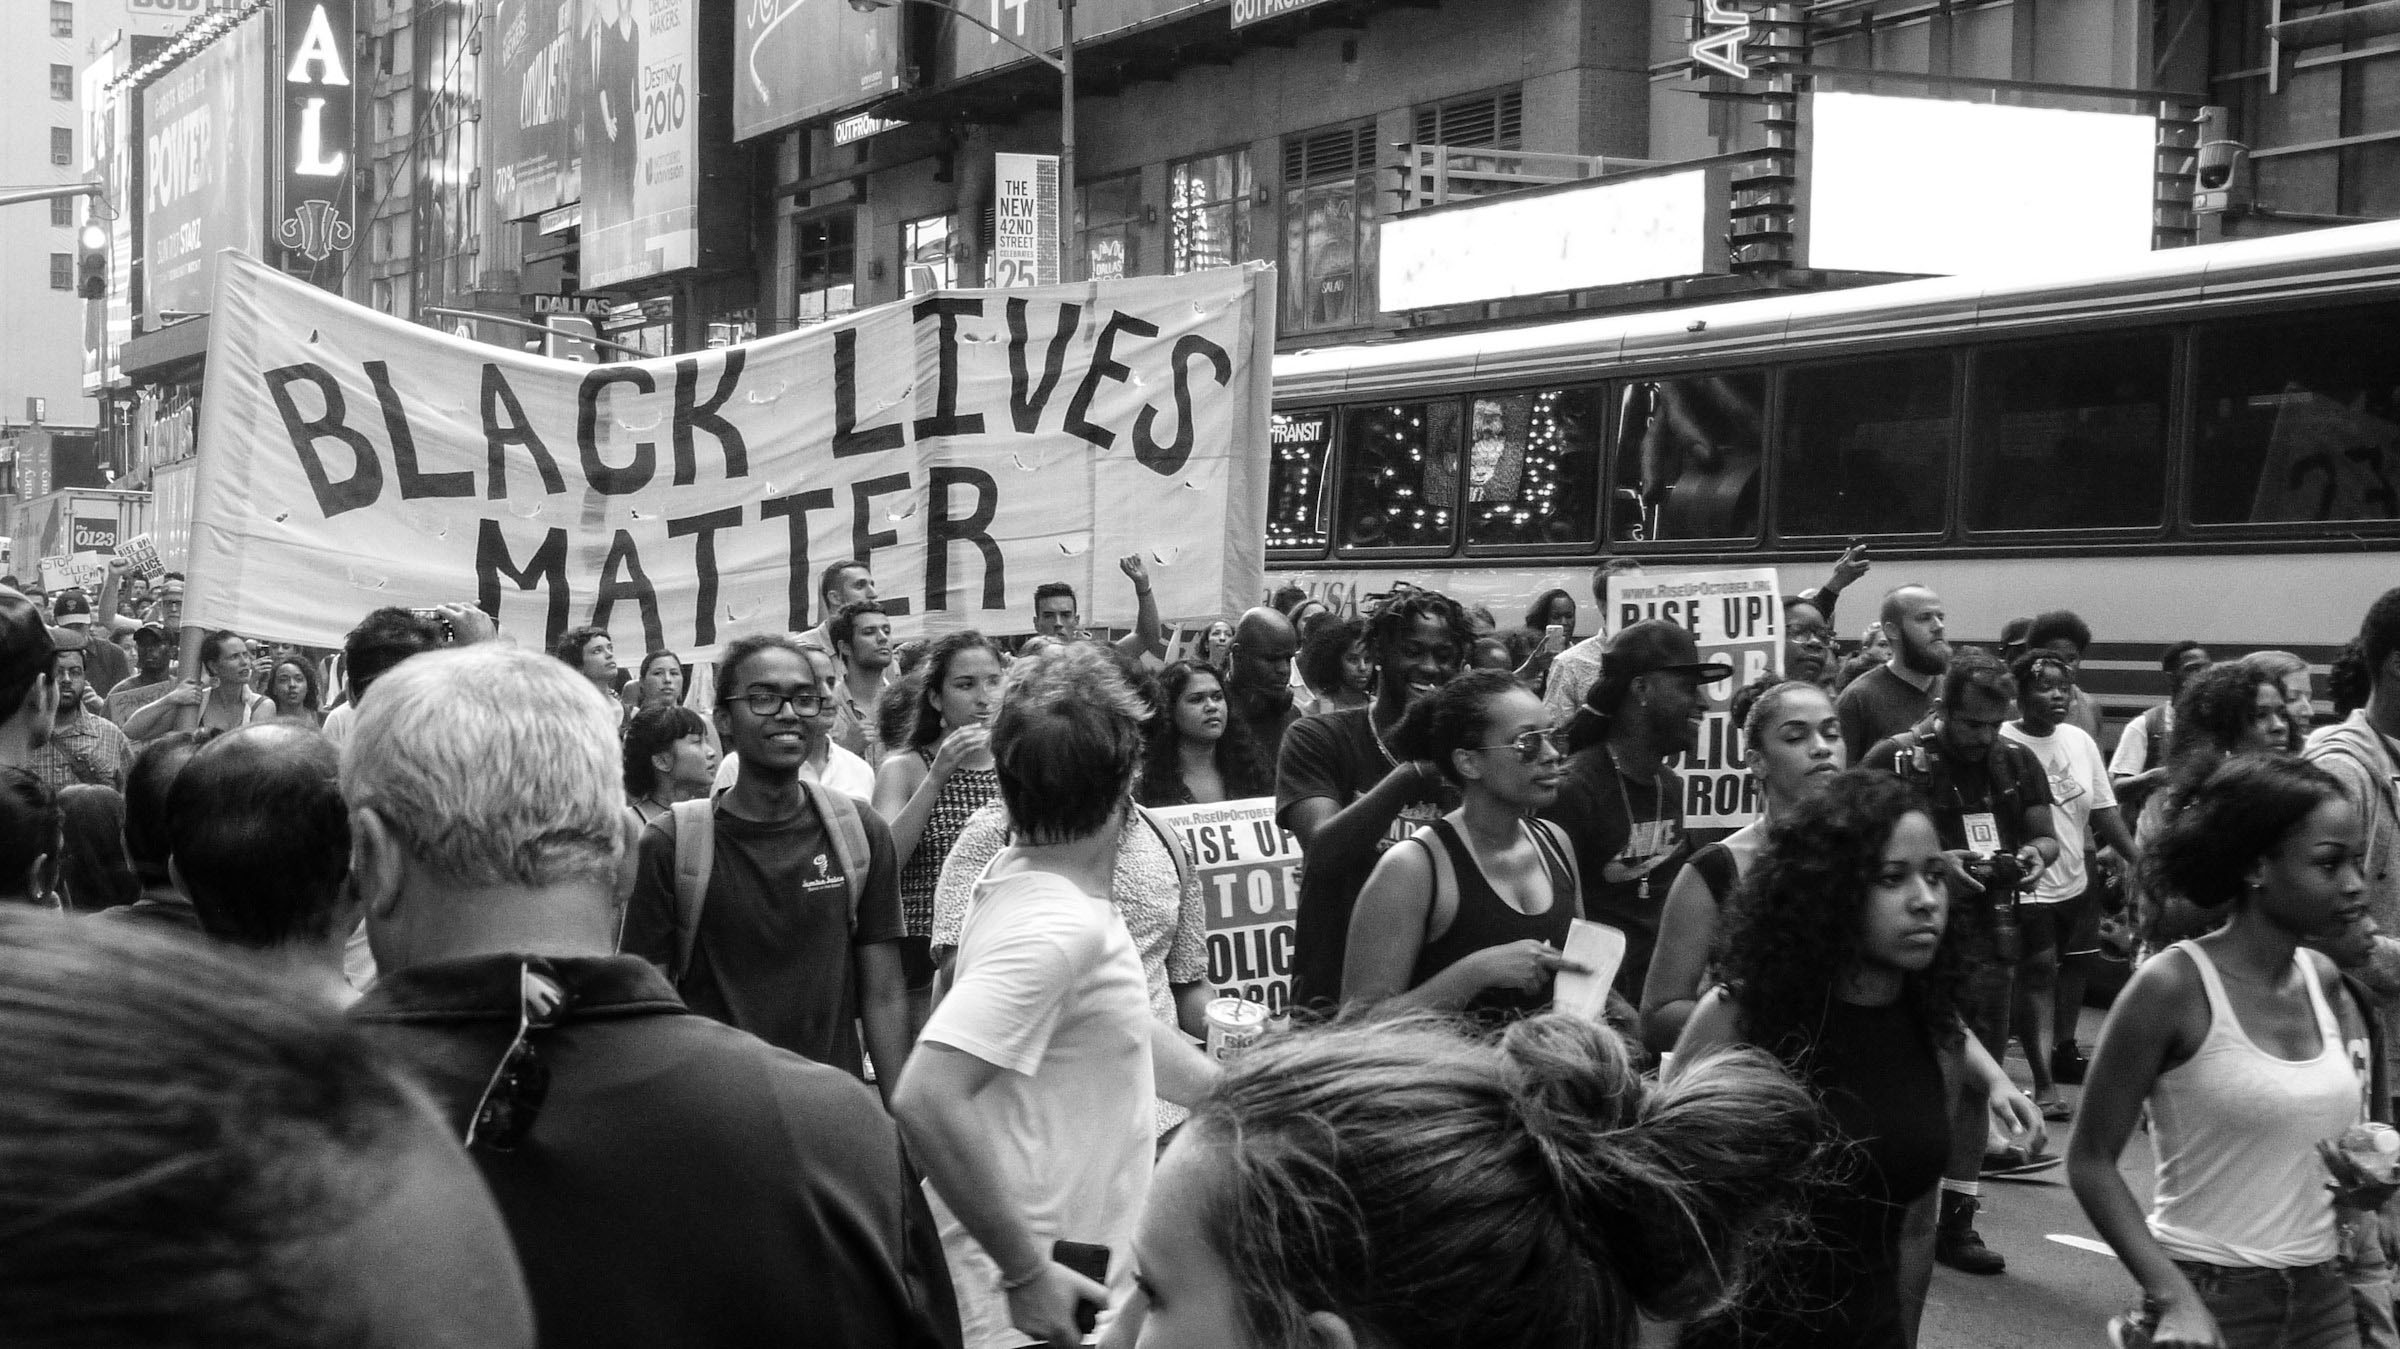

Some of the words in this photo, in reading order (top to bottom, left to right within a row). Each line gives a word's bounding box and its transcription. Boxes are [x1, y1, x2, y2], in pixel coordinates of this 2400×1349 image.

[644, 63, 685, 140] 2016
[149, 104, 213, 213] POWER
[1005, 180, 1028, 196] THE
[1000, 198, 1034, 217] NEW
[999, 219, 1034, 235] 42ND
[999, 235, 1034, 249] STREET
[998, 259, 1035, 288] 25
[535, 295, 612, 316] DALLAS
[264, 348, 749, 519] BLACK
[833, 297, 1233, 477] LIVES
[1272, 422, 1323, 444] TRANSIT
[43, 554, 74, 571] STOP
[475, 466, 1006, 654] MATTER
[1724, 595, 1774, 640] UP!
[1184, 825, 1240, 866] ISE
[1252, 820, 1296, 858] UP
[1211, 865, 1300, 919] TOP
[1206, 924, 1296, 985] OLIC
